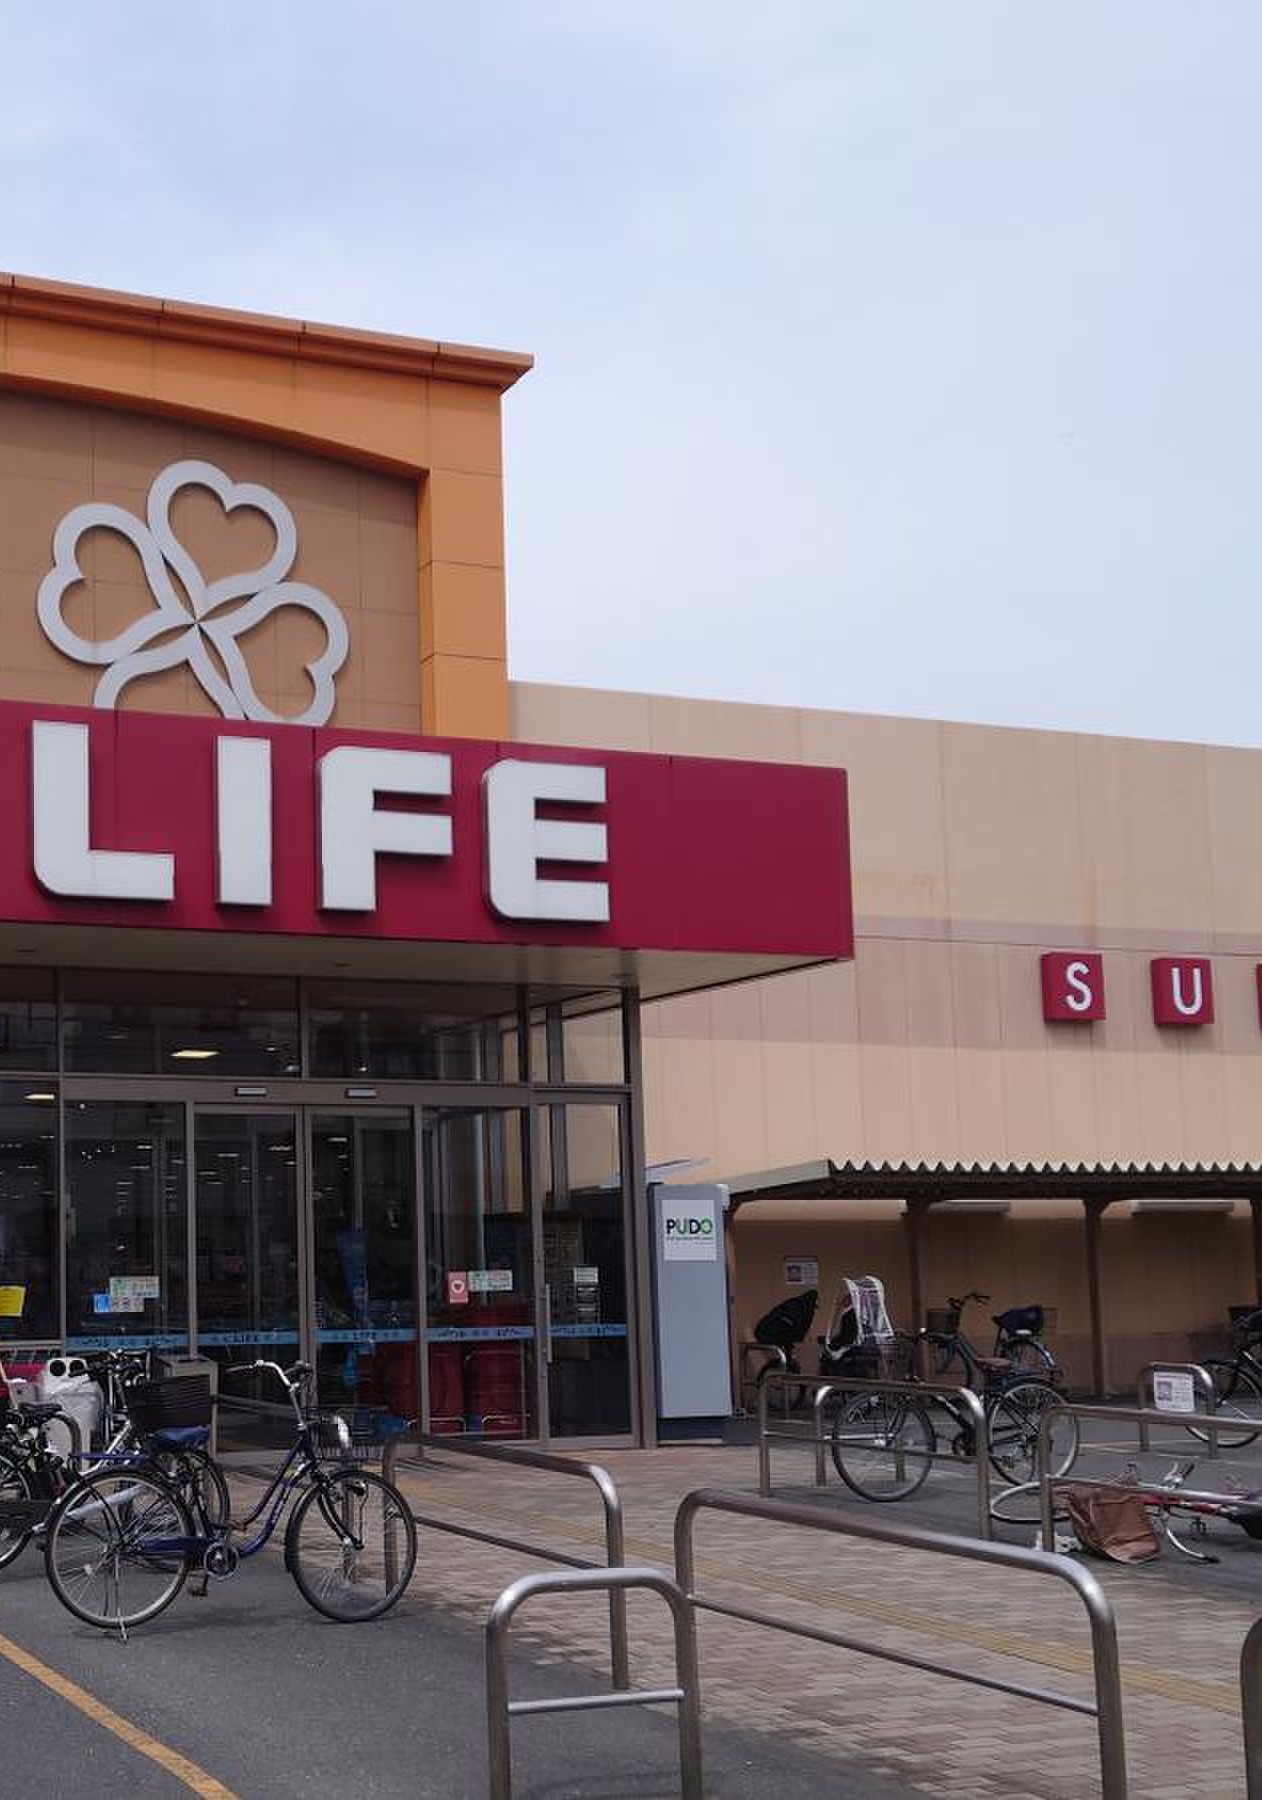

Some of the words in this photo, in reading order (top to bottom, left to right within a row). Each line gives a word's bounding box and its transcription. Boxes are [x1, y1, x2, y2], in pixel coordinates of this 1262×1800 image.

[31, 718, 611, 923] LIFE
[1065, 961, 1093, 1012] S
[1171, 967, 1203, 1015] U
[665, 1218, 714, 1235] PUDO
